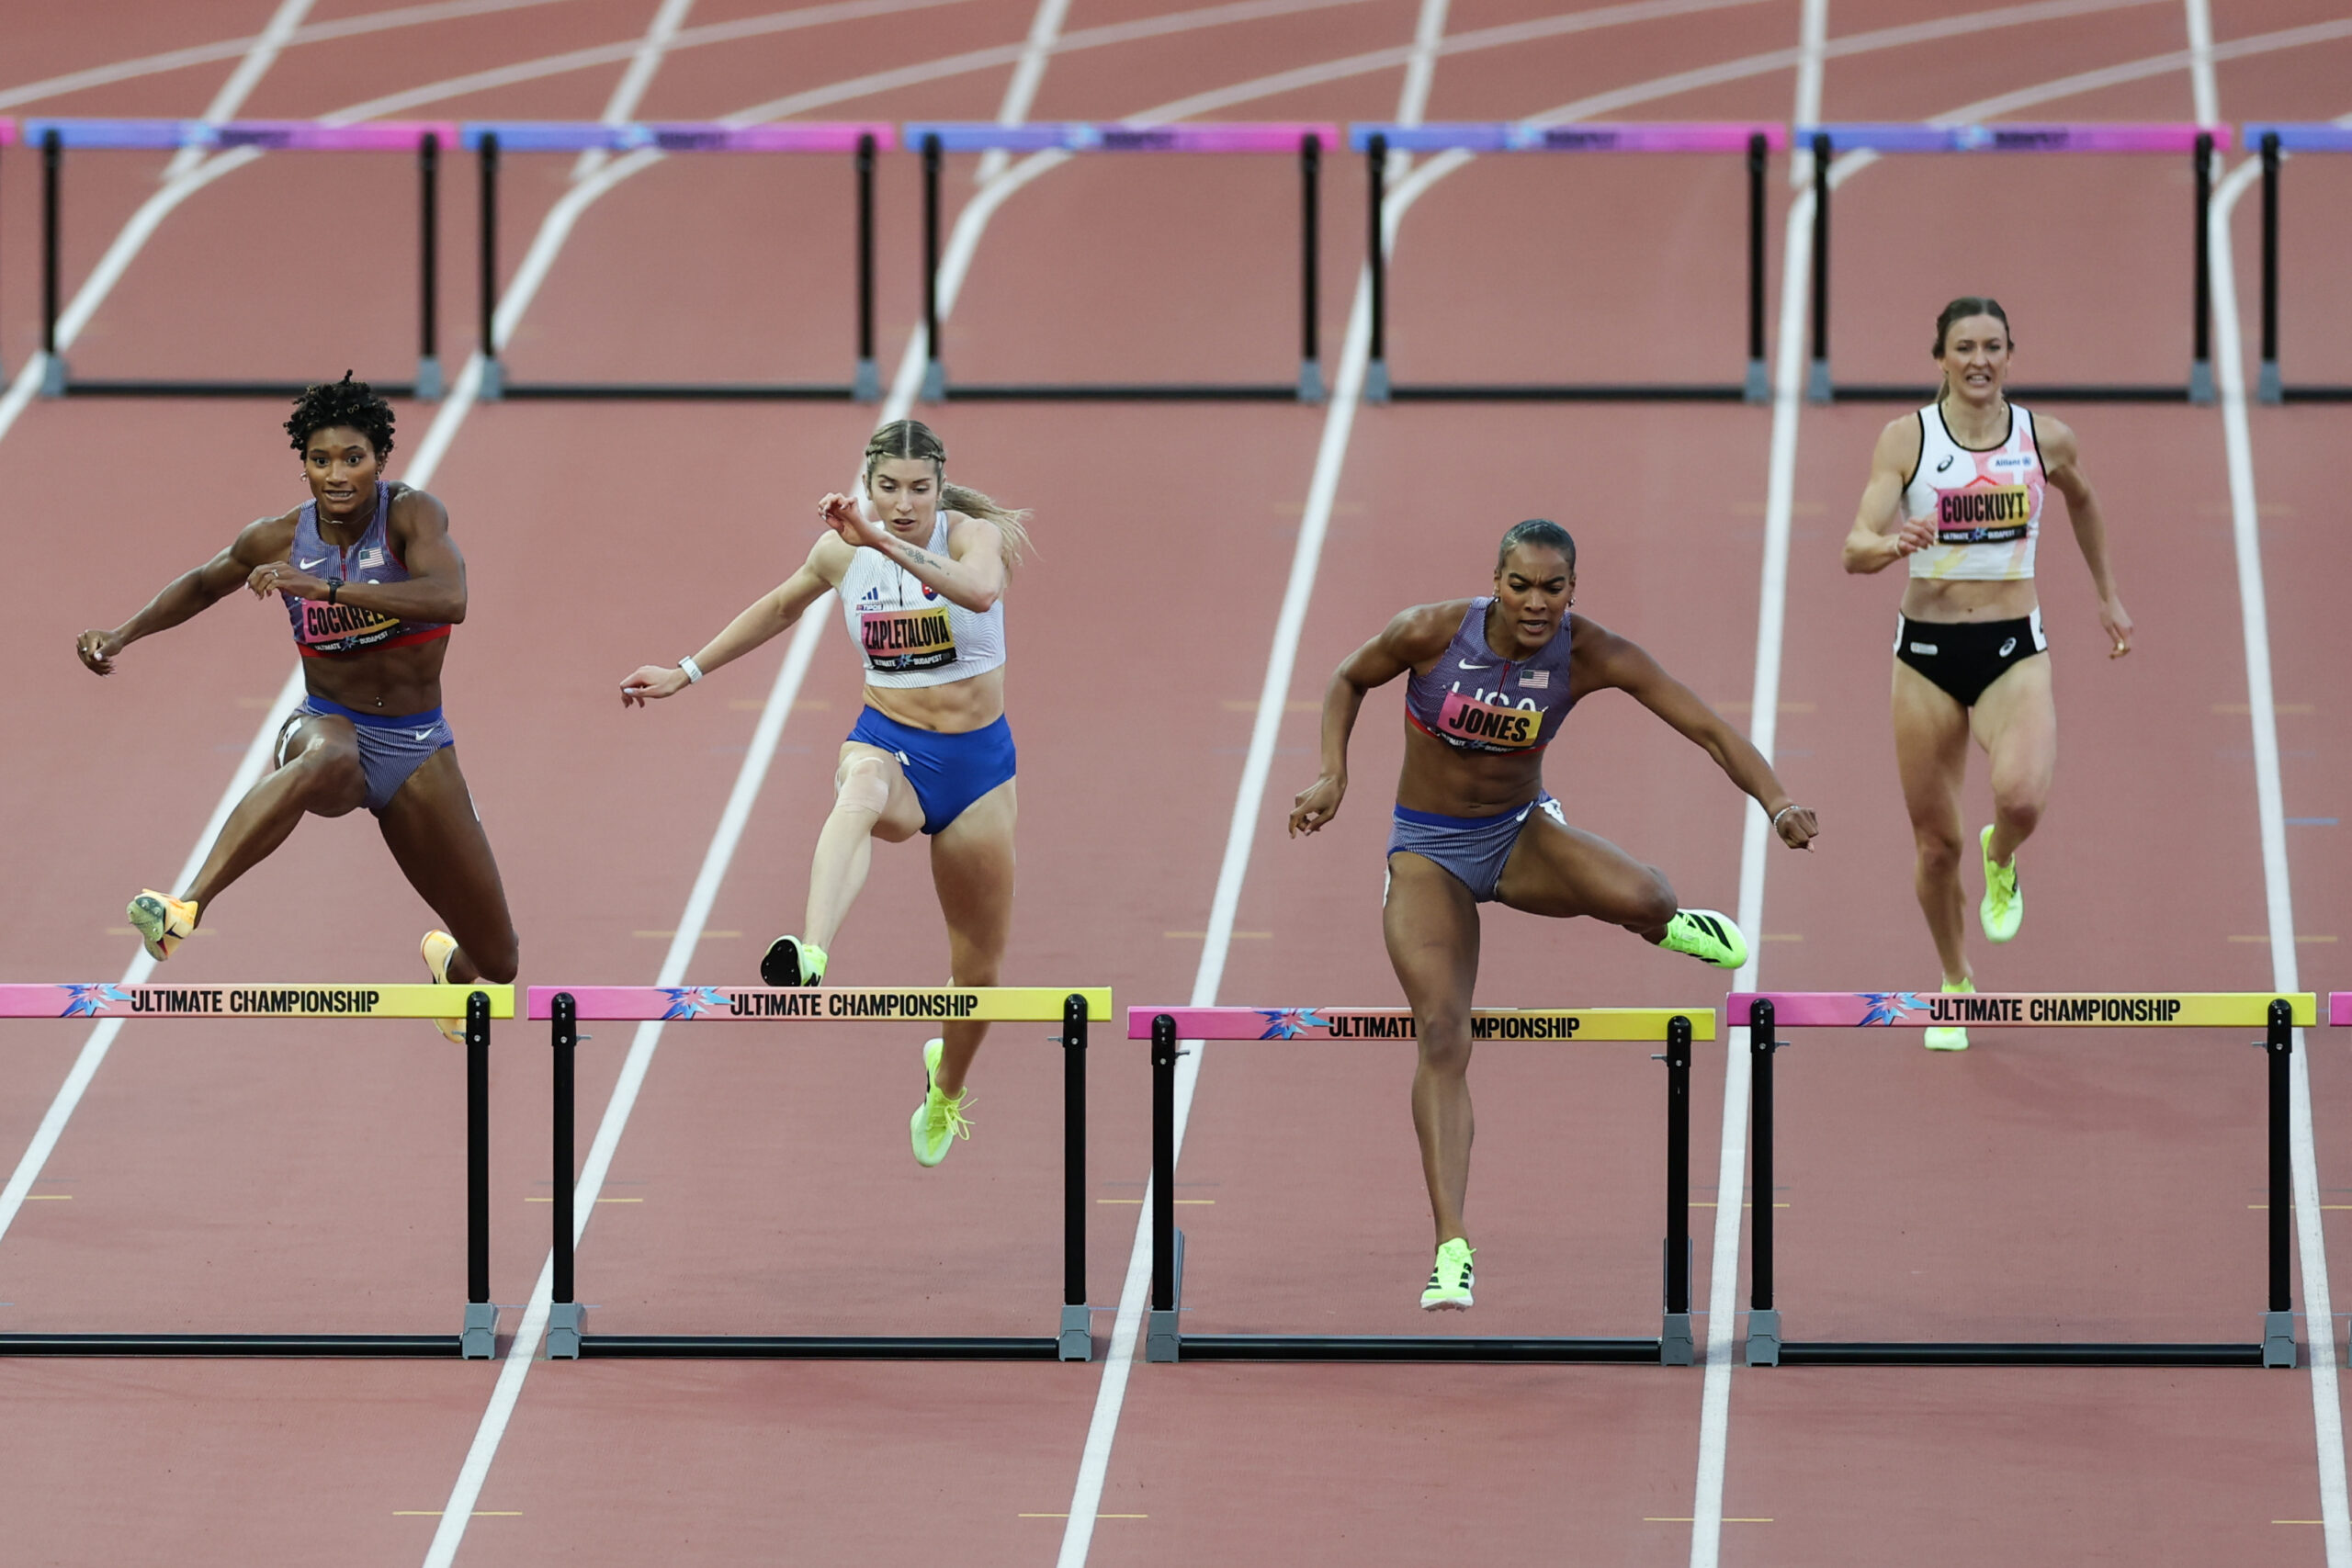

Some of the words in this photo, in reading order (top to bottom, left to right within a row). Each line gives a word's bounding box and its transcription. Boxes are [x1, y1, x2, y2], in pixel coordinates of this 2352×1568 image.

[1941, 491, 2024, 524] COUCKUYT
[359, 631, 389, 645] BUDAPEST
[865, 615, 950, 650] ZAPLETALOVA
[913, 653, 943, 665] BUDAPEST
[1449, 704, 1530, 742] JONES
[131, 990, 223, 1012] ULTIMATE
[230, 990, 379, 1012] CHAMPIONSHIP
[730, 994, 821, 1016] ULTIMATE
[829, 994, 978, 1017] CHAMPIONSHIP
[1929, 998, 2022, 1021] ULTIMATE
[2030, 999, 2180, 1021] CHAMPIONSHIP
[1471, 1017, 1580, 1039] MPIONSHIP
